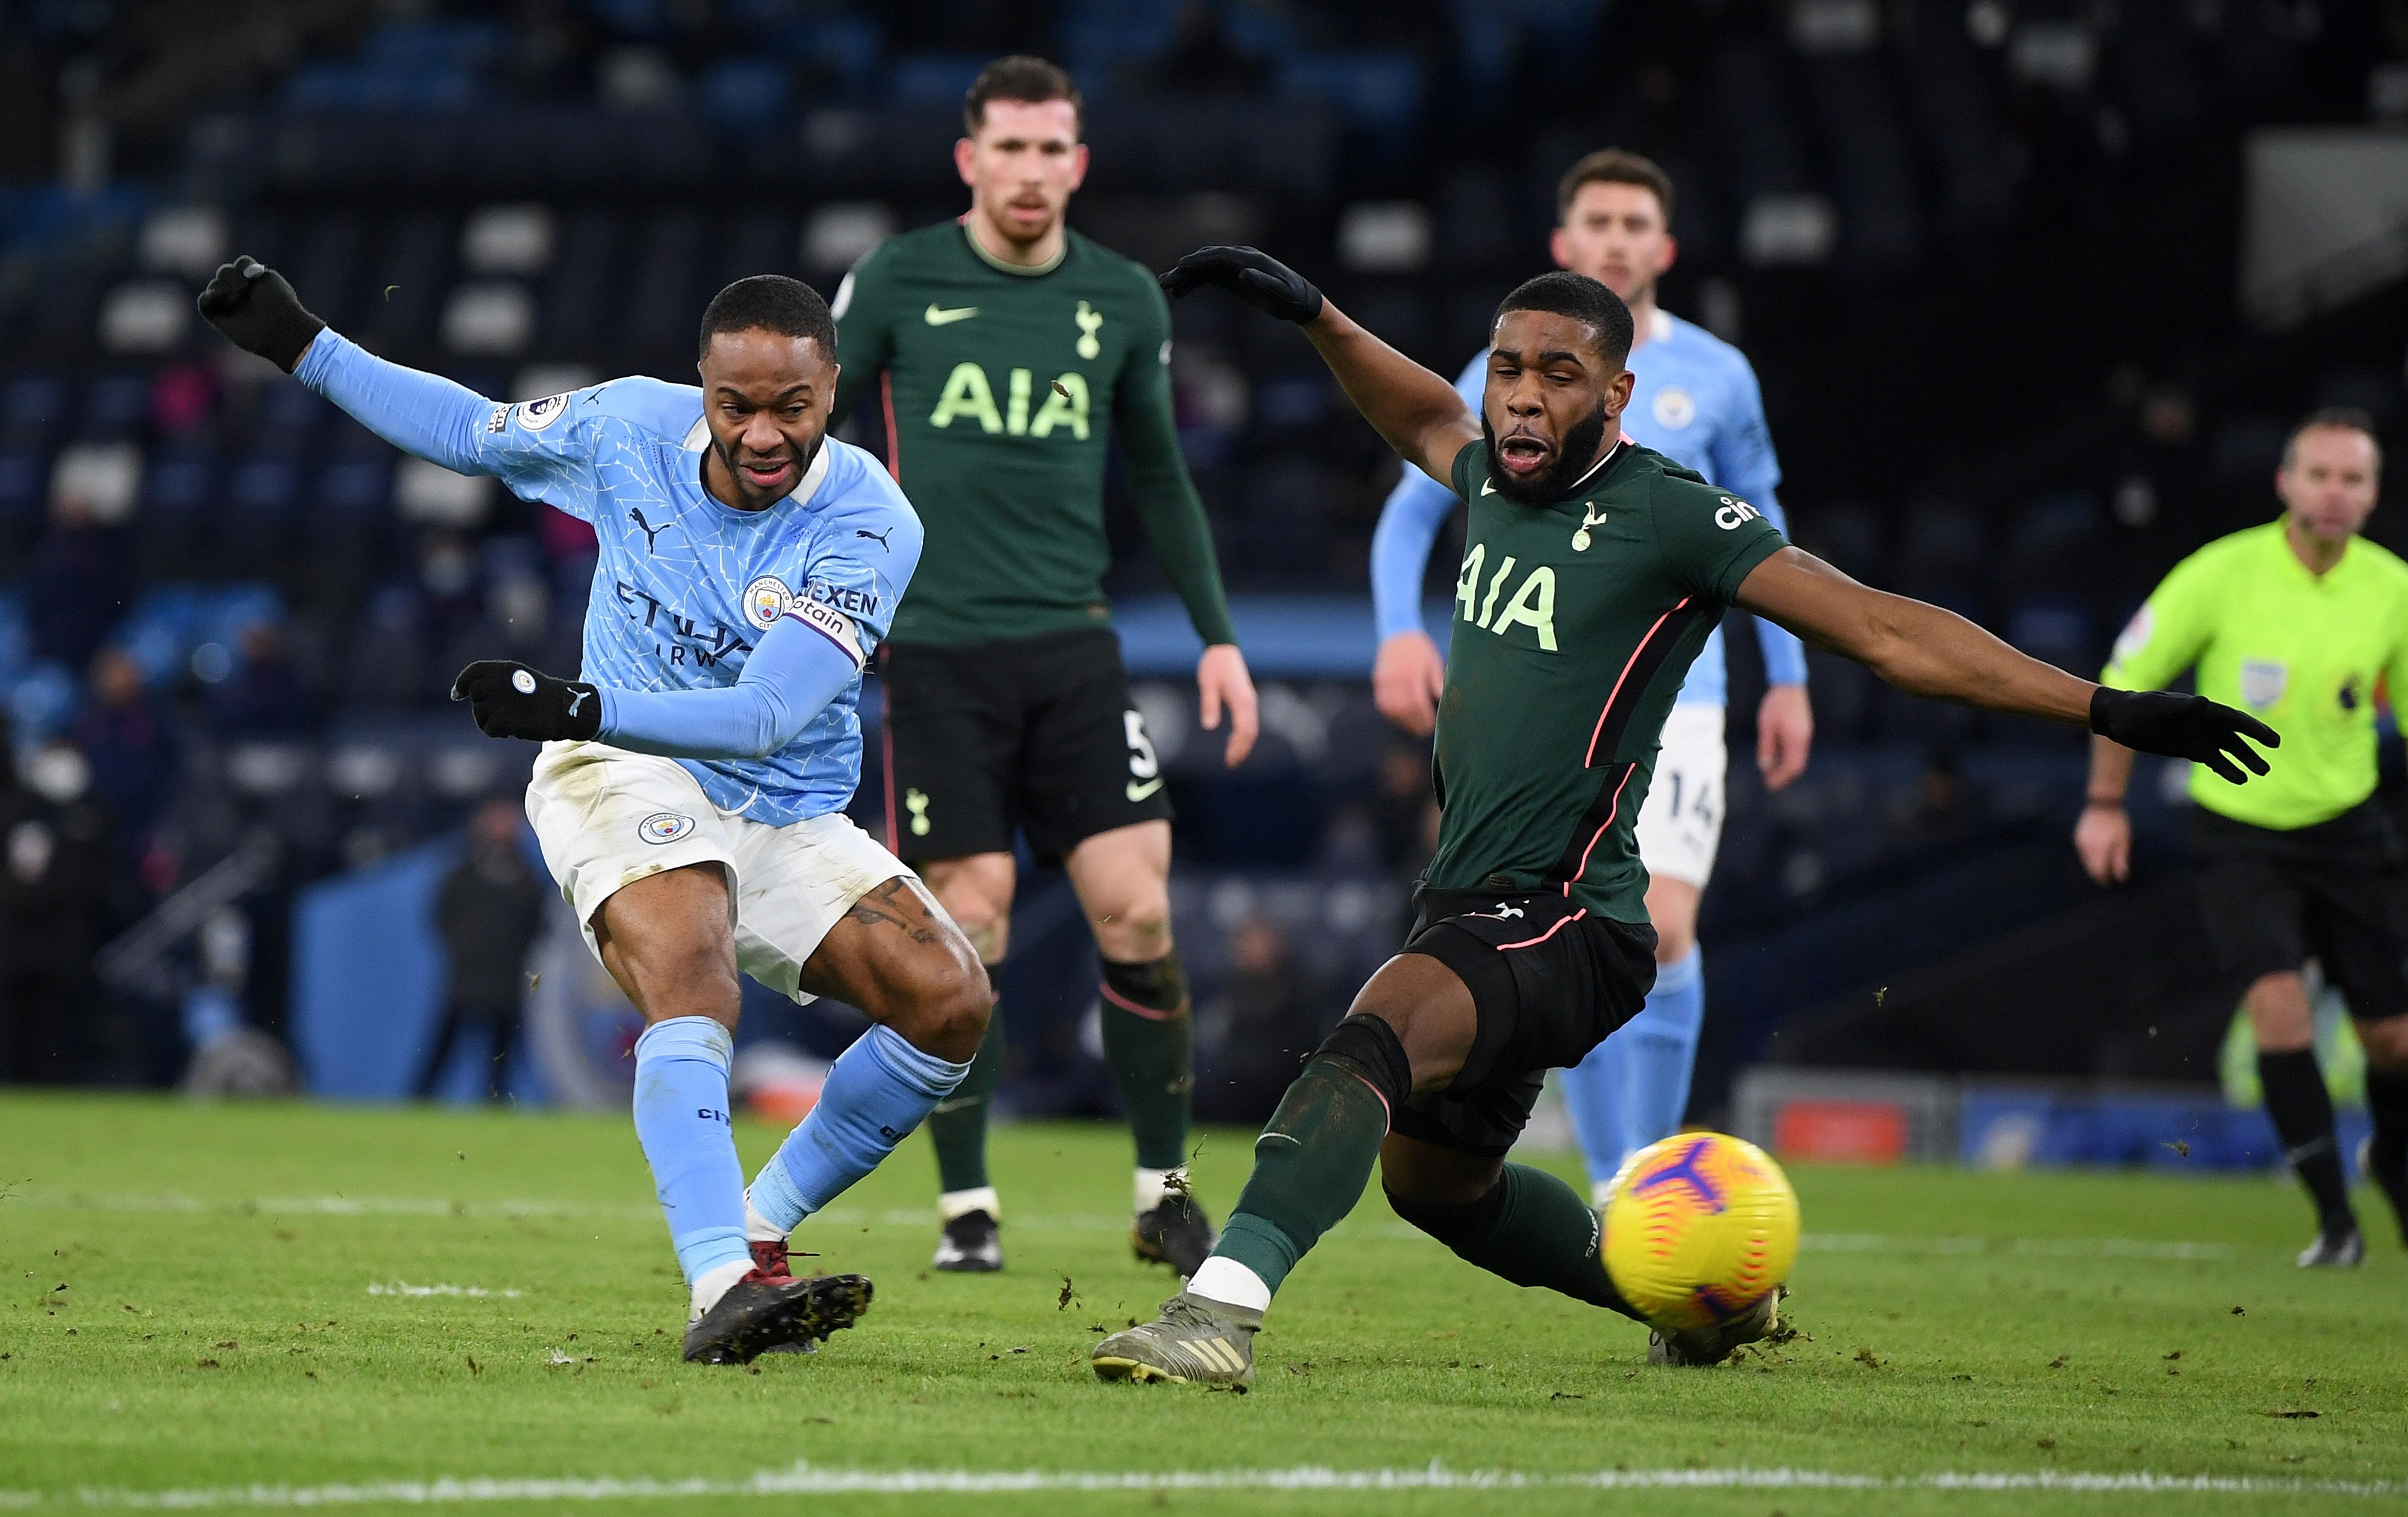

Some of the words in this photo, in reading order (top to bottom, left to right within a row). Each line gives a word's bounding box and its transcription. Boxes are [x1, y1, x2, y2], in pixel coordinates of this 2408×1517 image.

[929, 362, 1091, 440] AIA
[749, 580, 790, 601] MANCHESTER
[1456, 543, 1558, 651] AIA
[1122, 710, 1158, 778] 5
[1669, 770, 1713, 829] 14
